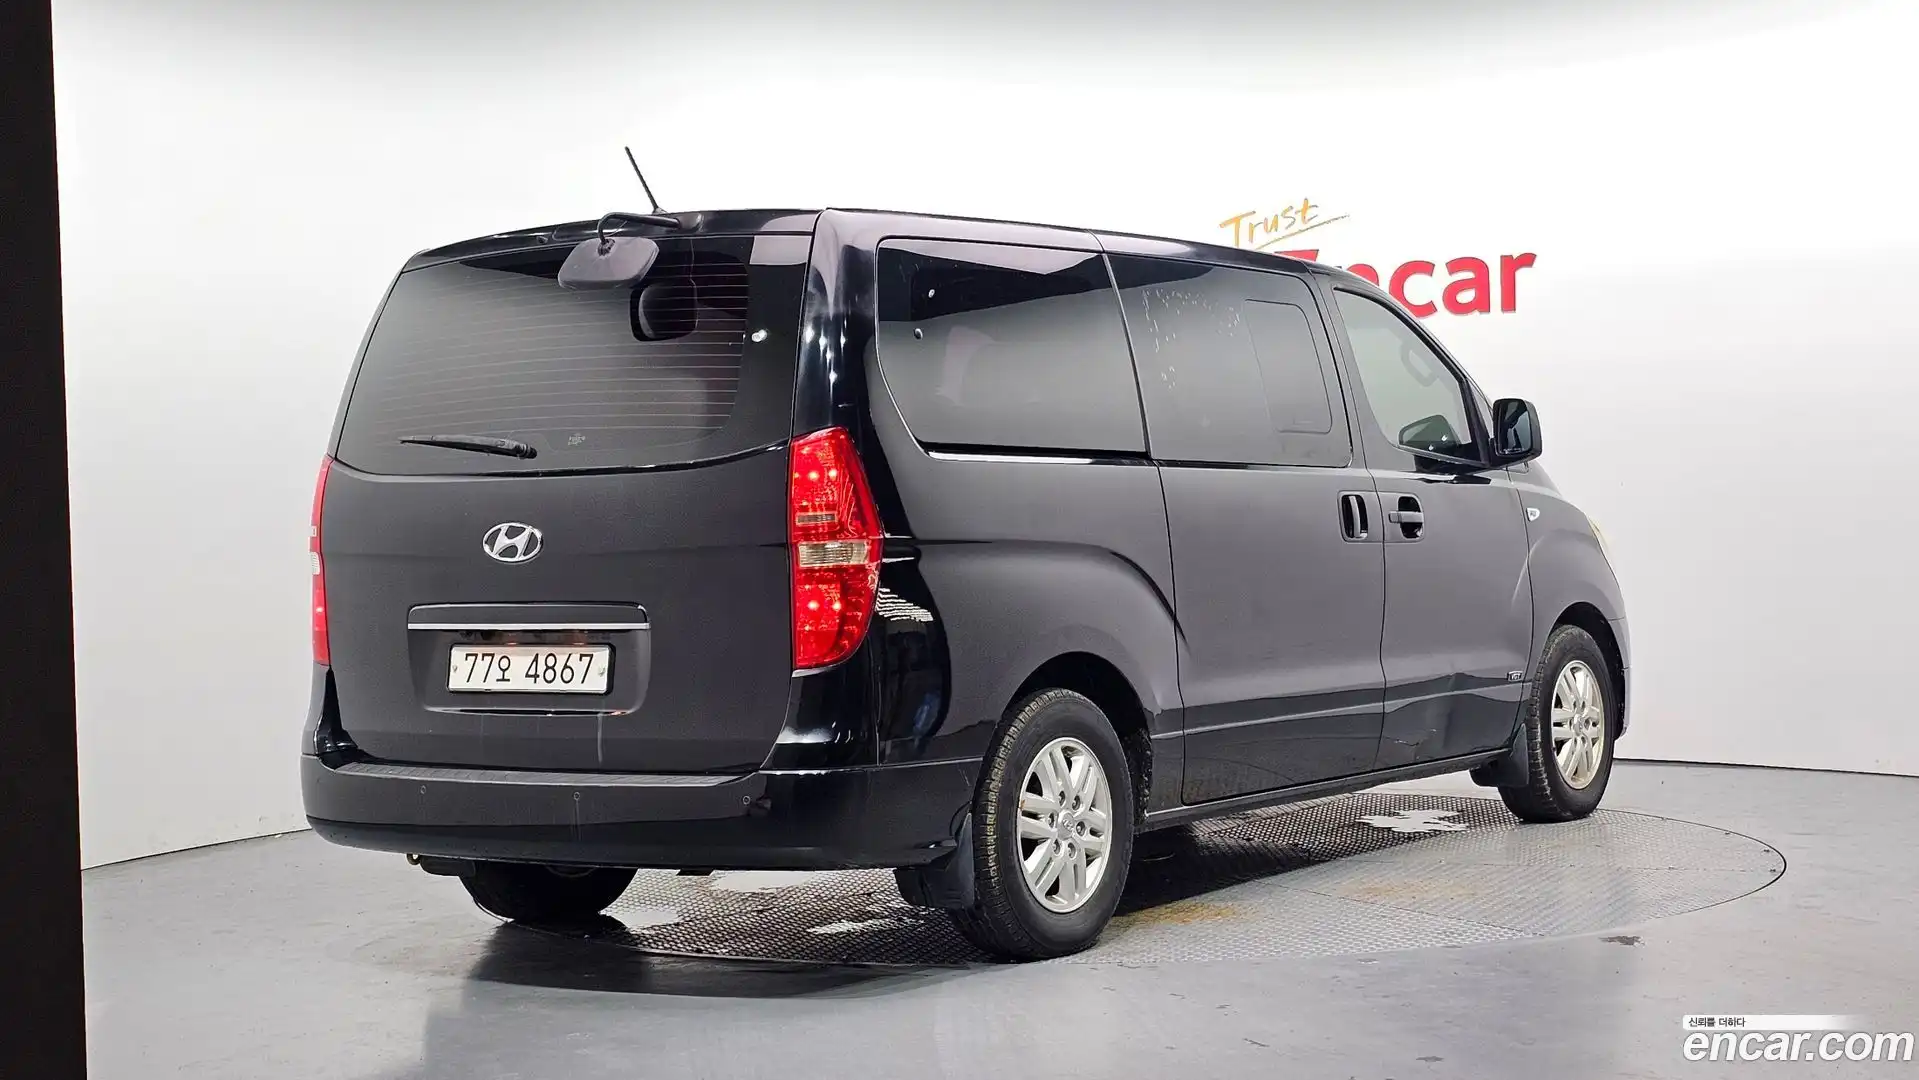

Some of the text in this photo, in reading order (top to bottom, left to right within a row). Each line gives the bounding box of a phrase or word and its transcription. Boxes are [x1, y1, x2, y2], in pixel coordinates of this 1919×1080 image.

[1219, 197, 1319, 248] Trust
[464, 652, 594, 684] 77오 4867
